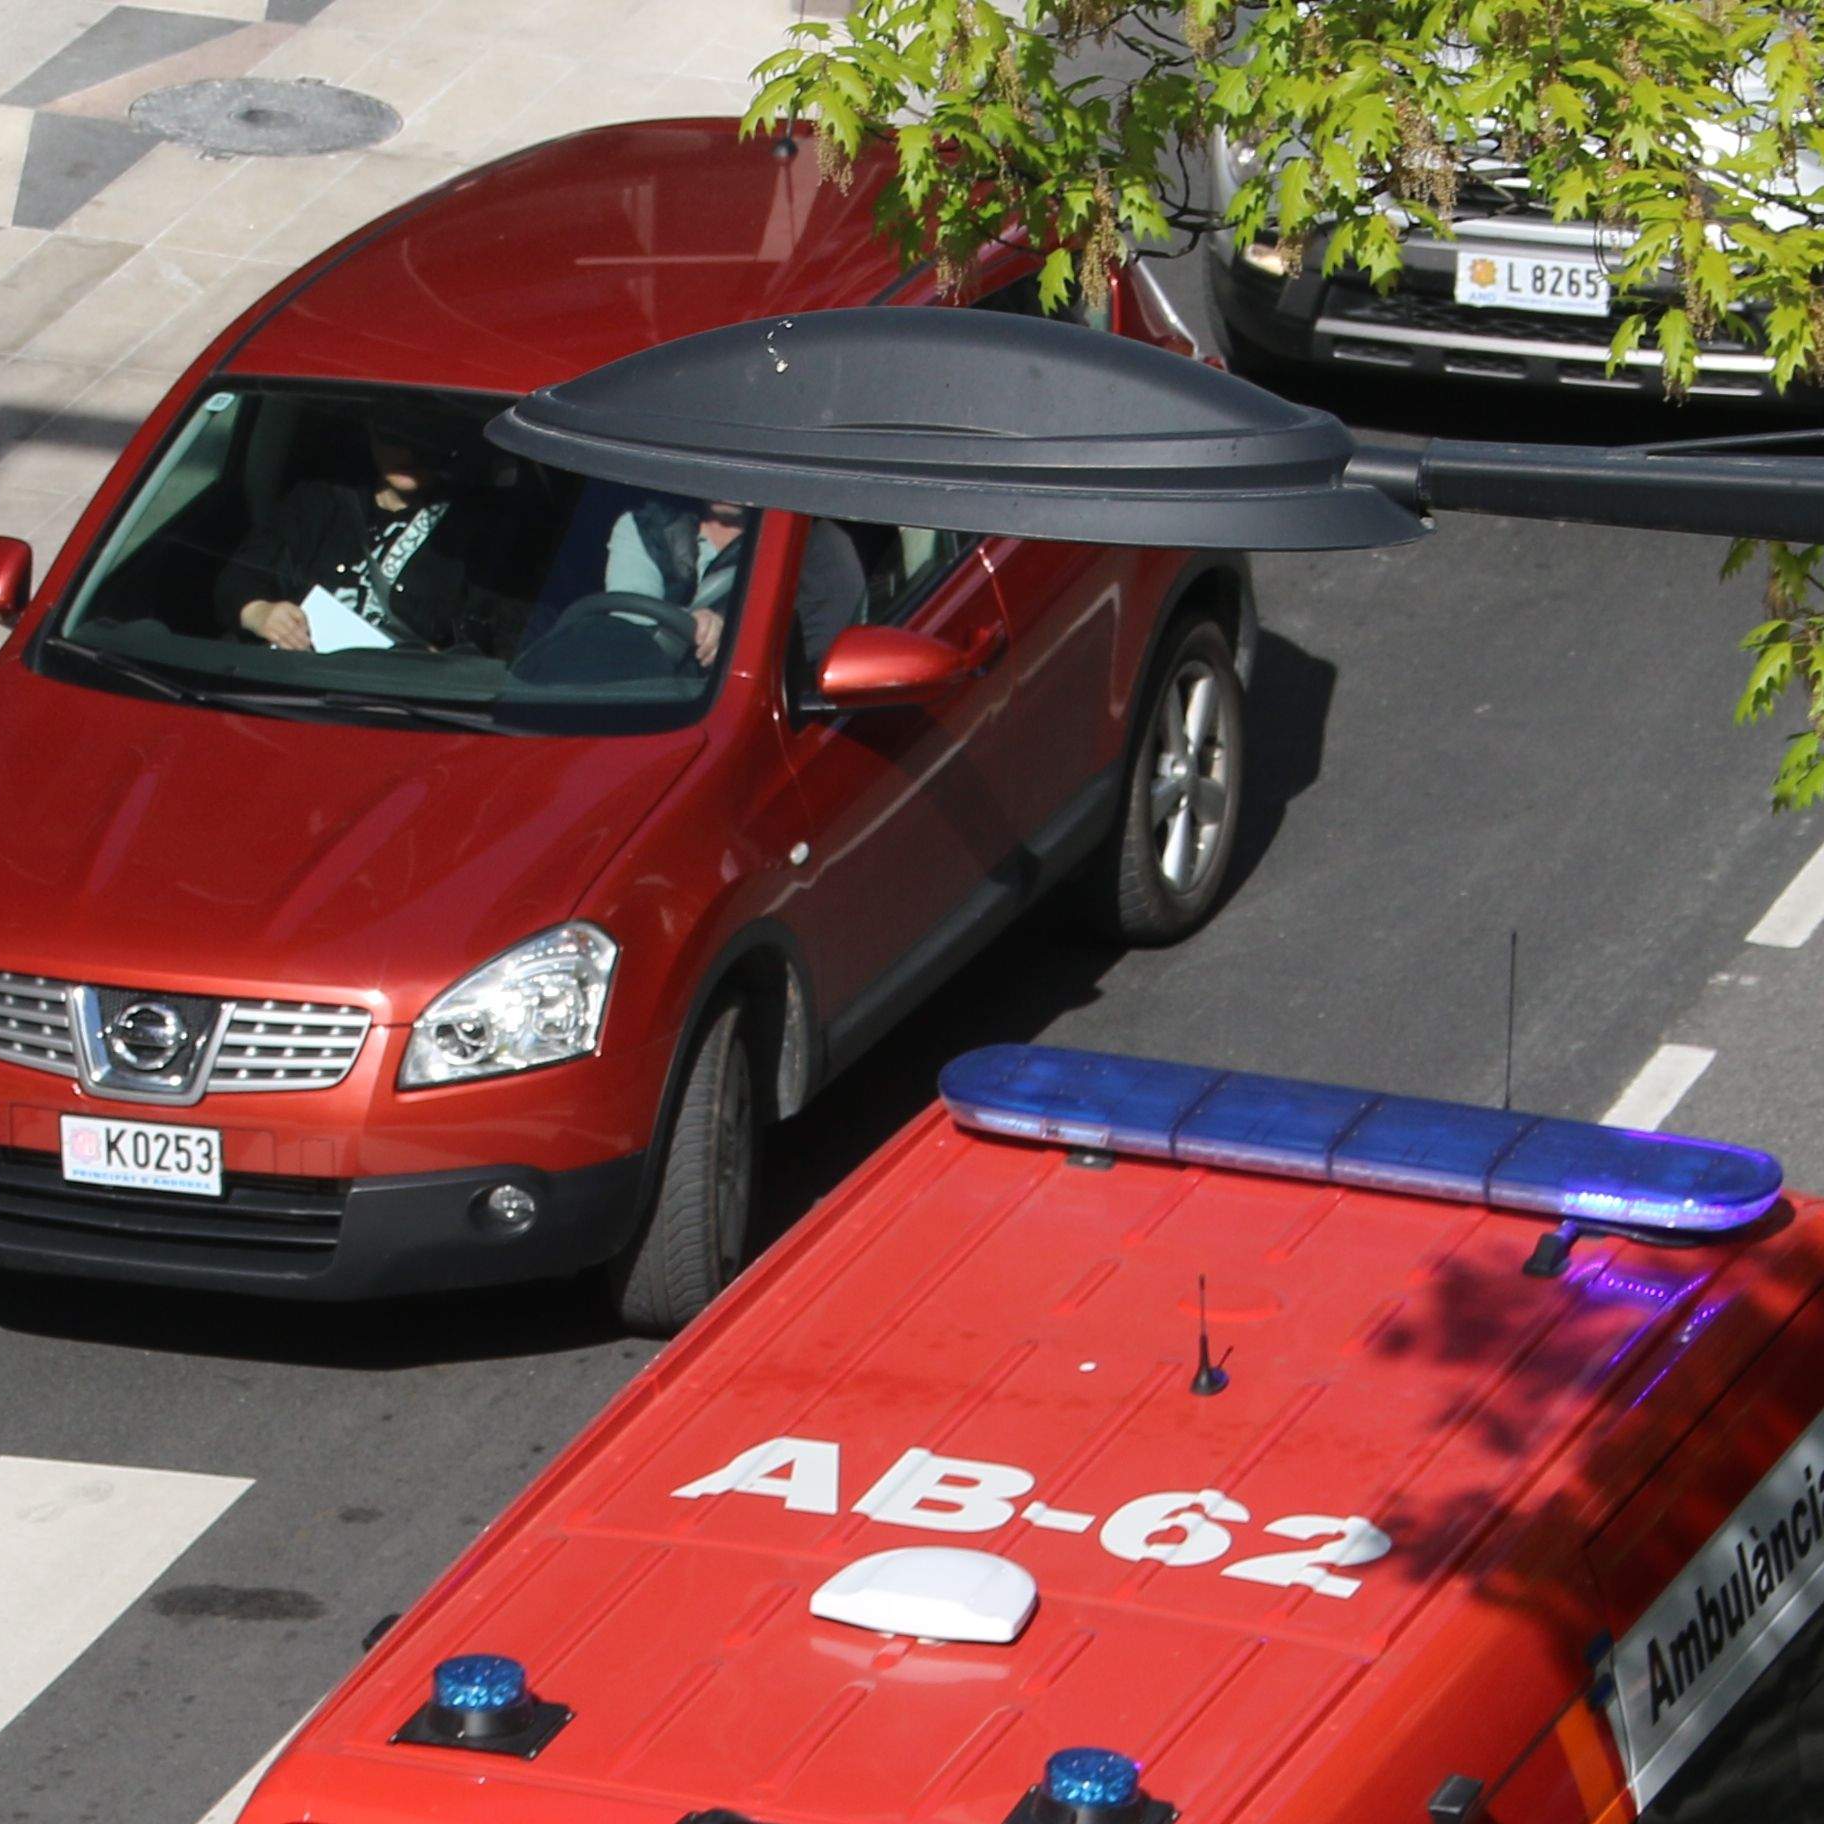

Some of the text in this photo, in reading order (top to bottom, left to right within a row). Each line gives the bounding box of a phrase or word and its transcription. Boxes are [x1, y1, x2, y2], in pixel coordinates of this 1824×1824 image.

[1507, 261, 1600, 299] L 8265
[105, 1127, 214, 1175] K0253
[670, 1435, 1394, 1601] AB-62
